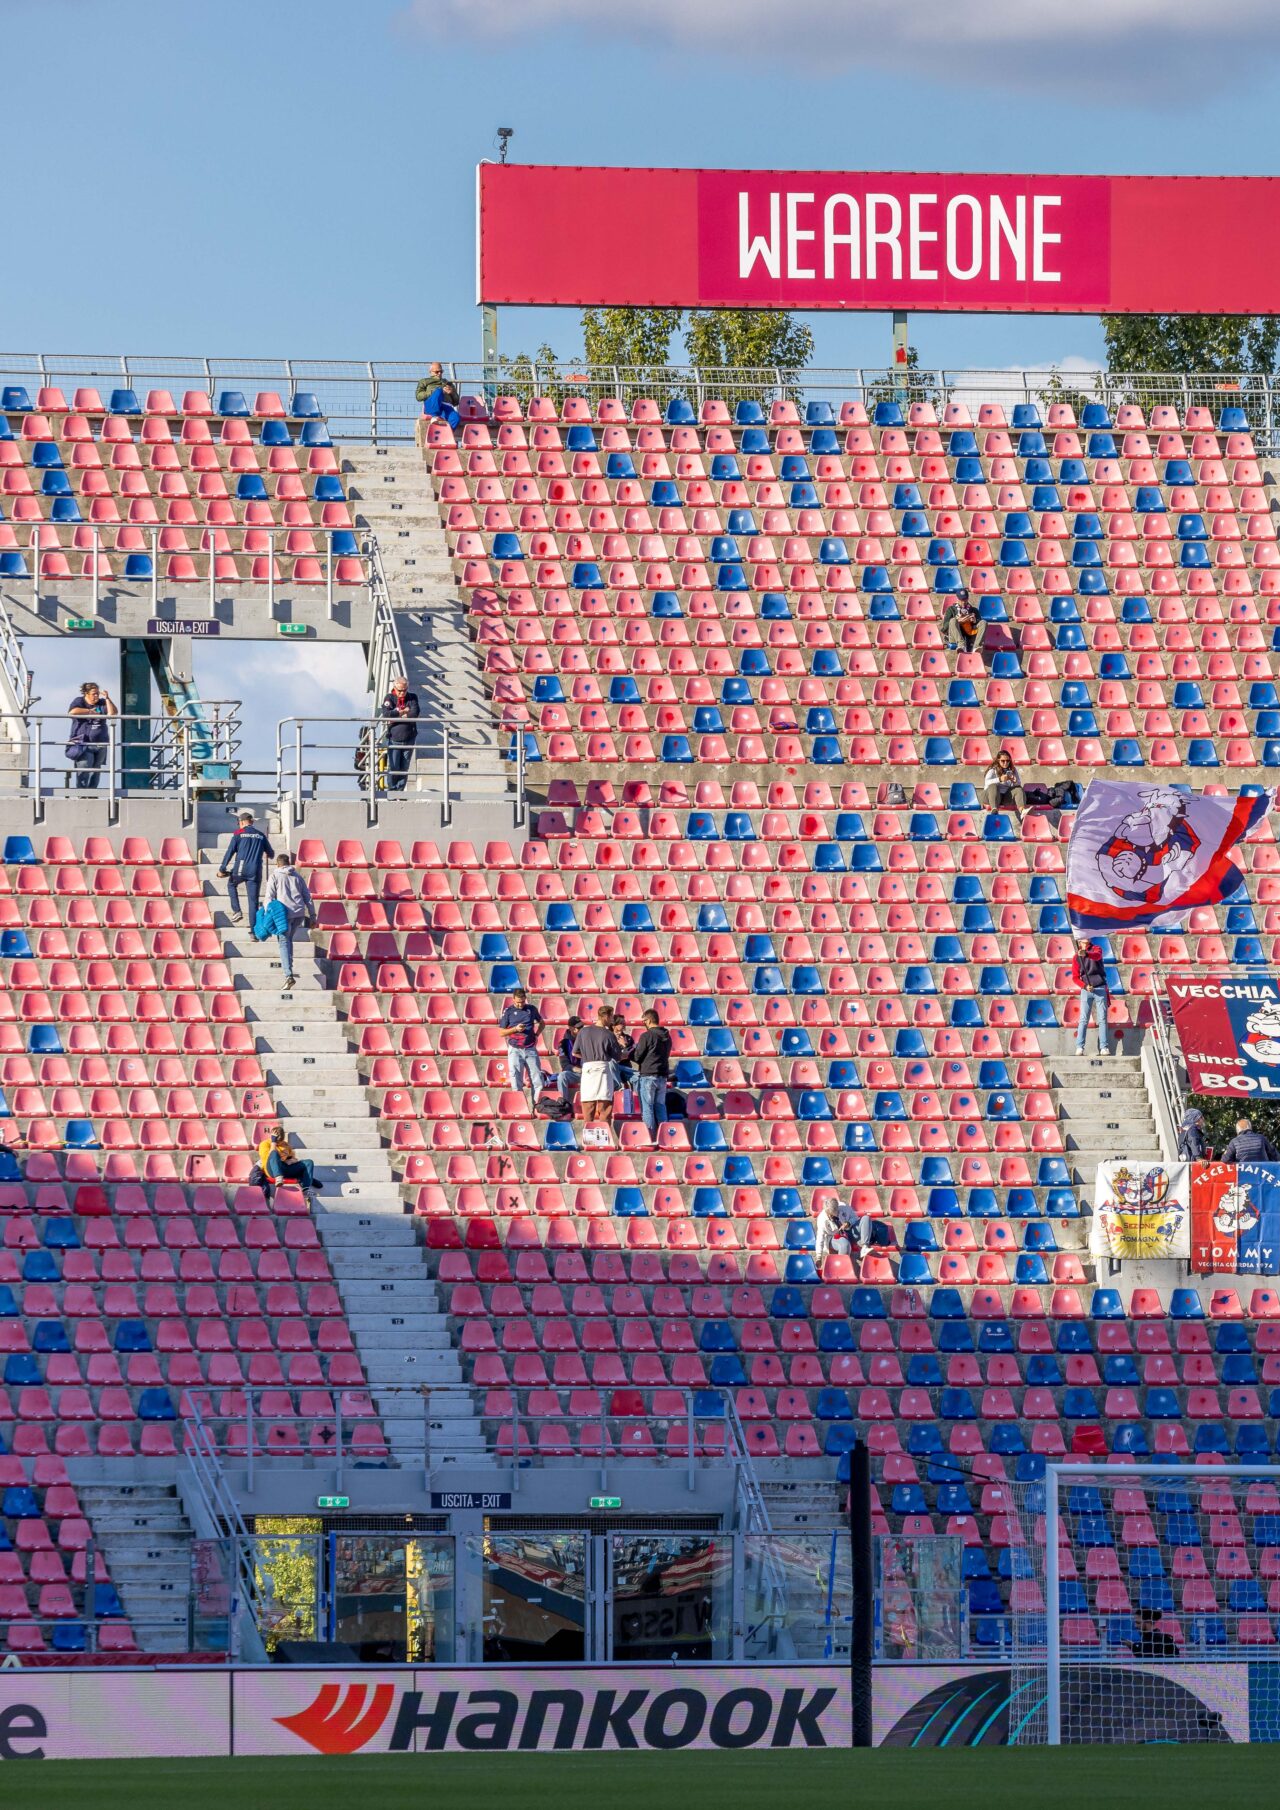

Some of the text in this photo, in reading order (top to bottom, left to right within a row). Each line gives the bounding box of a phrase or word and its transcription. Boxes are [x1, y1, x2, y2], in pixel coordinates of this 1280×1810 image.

[738, 192, 1062, 282] WEAREONE
[192, 621, 209, 634] EXIT
[1172, 984, 1277, 999] VECCHIA
[1188, 1052, 1248, 1066] since
[1194, 1173, 1210, 1186] TE
[1210, 1165, 1224, 1176] CE
[1200, 1246, 1272, 1258] TOMMY
[441, 1494, 473, 1508] USCITA
[482, 1494, 501, 1508] EXIT
